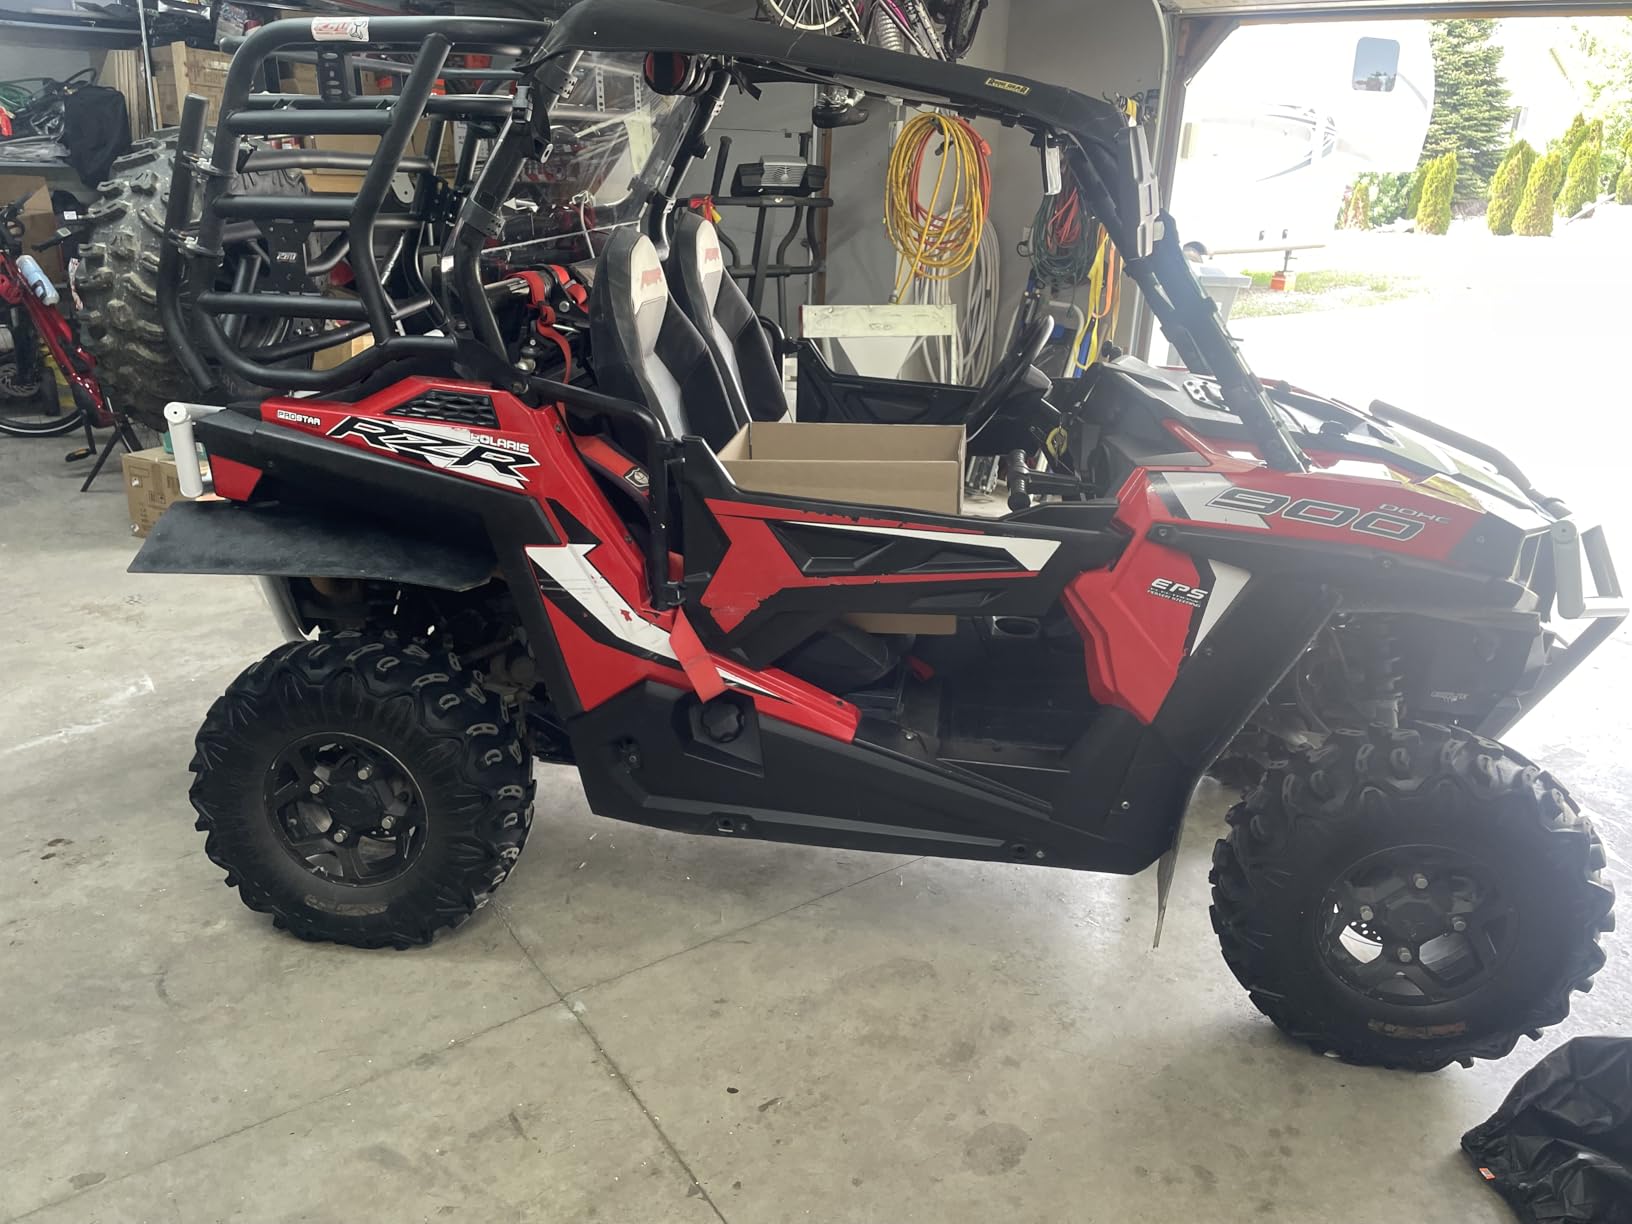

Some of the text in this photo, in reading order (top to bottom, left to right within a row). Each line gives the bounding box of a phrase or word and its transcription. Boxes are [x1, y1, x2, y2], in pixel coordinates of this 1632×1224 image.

[277, 409, 321, 426] PROSTAR
[325, 416, 541, 482] RZR
[469, 433, 530, 454] POLARIS
[1205, 487, 1426, 542] 900
[1379, 503, 1451, 525] DOHC
[1151, 578, 1209, 600] EPS
